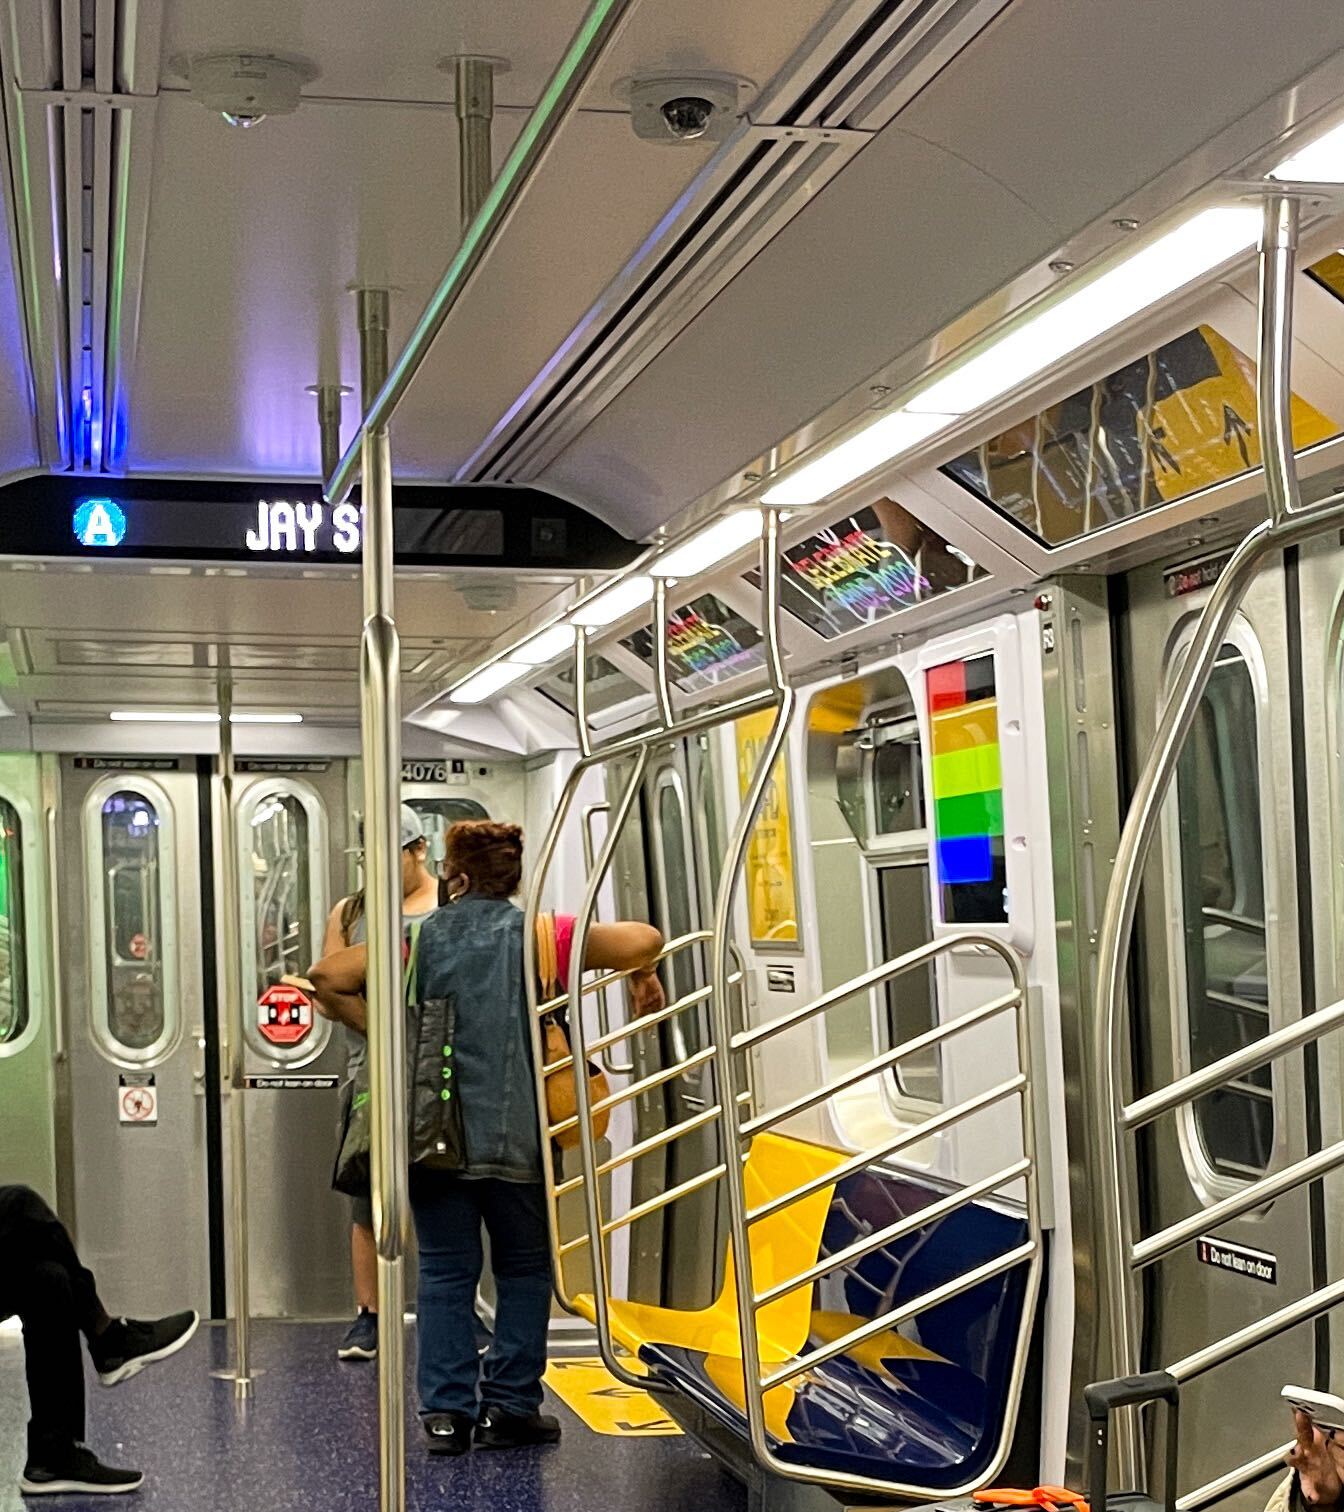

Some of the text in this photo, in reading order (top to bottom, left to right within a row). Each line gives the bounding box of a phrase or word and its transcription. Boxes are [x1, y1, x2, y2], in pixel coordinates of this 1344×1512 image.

[85, 503, 117, 546] A
[246, 501, 364, 553] JAY S
[400, 763, 446, 781] 4076
[1256, 1260, 1272, 1279] door
